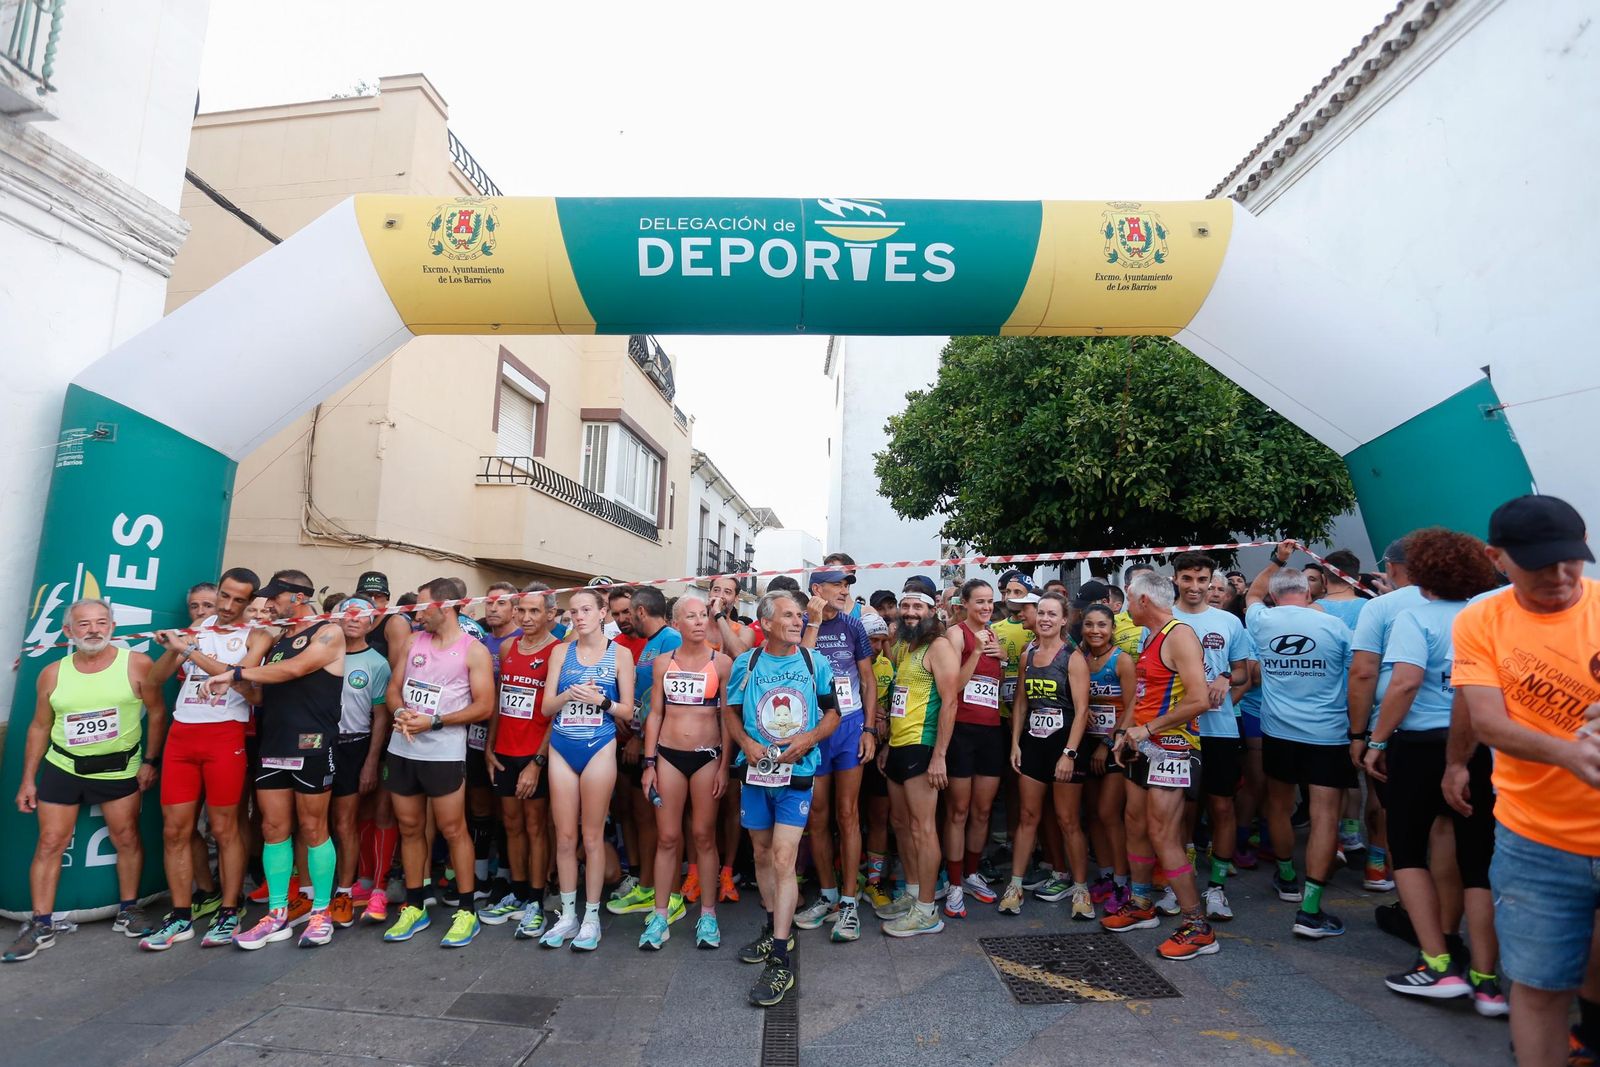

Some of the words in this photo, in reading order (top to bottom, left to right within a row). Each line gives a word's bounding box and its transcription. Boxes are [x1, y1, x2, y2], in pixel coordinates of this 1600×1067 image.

[639, 216, 767, 231] DELEGACIÓN
[773, 220, 796, 232] de
[638, 237, 956, 282] DEPORTES
[422, 265, 451, 273] Excmo.
[452, 266, 505, 275] Ayuntamiento
[438, 276, 448, 284] de
[449, 276, 462, 284] Los
[464, 276, 492, 284] Barrios
[1095, 273, 1122, 281] Excmo.
[1123, 273, 1173, 282] Ayuntamiento
[1106, 283, 1116, 291] de
[1117, 283, 1130, 291] Los
[1131, 283, 1158, 291] Barrios
[1264, 659, 1327, 669] HYUNDAI
[671, 681, 695, 694] 331
[975, 684, 994, 696] 324
[409, 689, 429, 705] 101
[505, 694, 525, 708] 127
[1520, 673, 1589, 721] NOCTU
[570, 703, 594, 716] 315
[76, 719, 108, 735] 299
[1035, 716, 1053, 727] 270
[1157, 762, 1182, 774] 441
